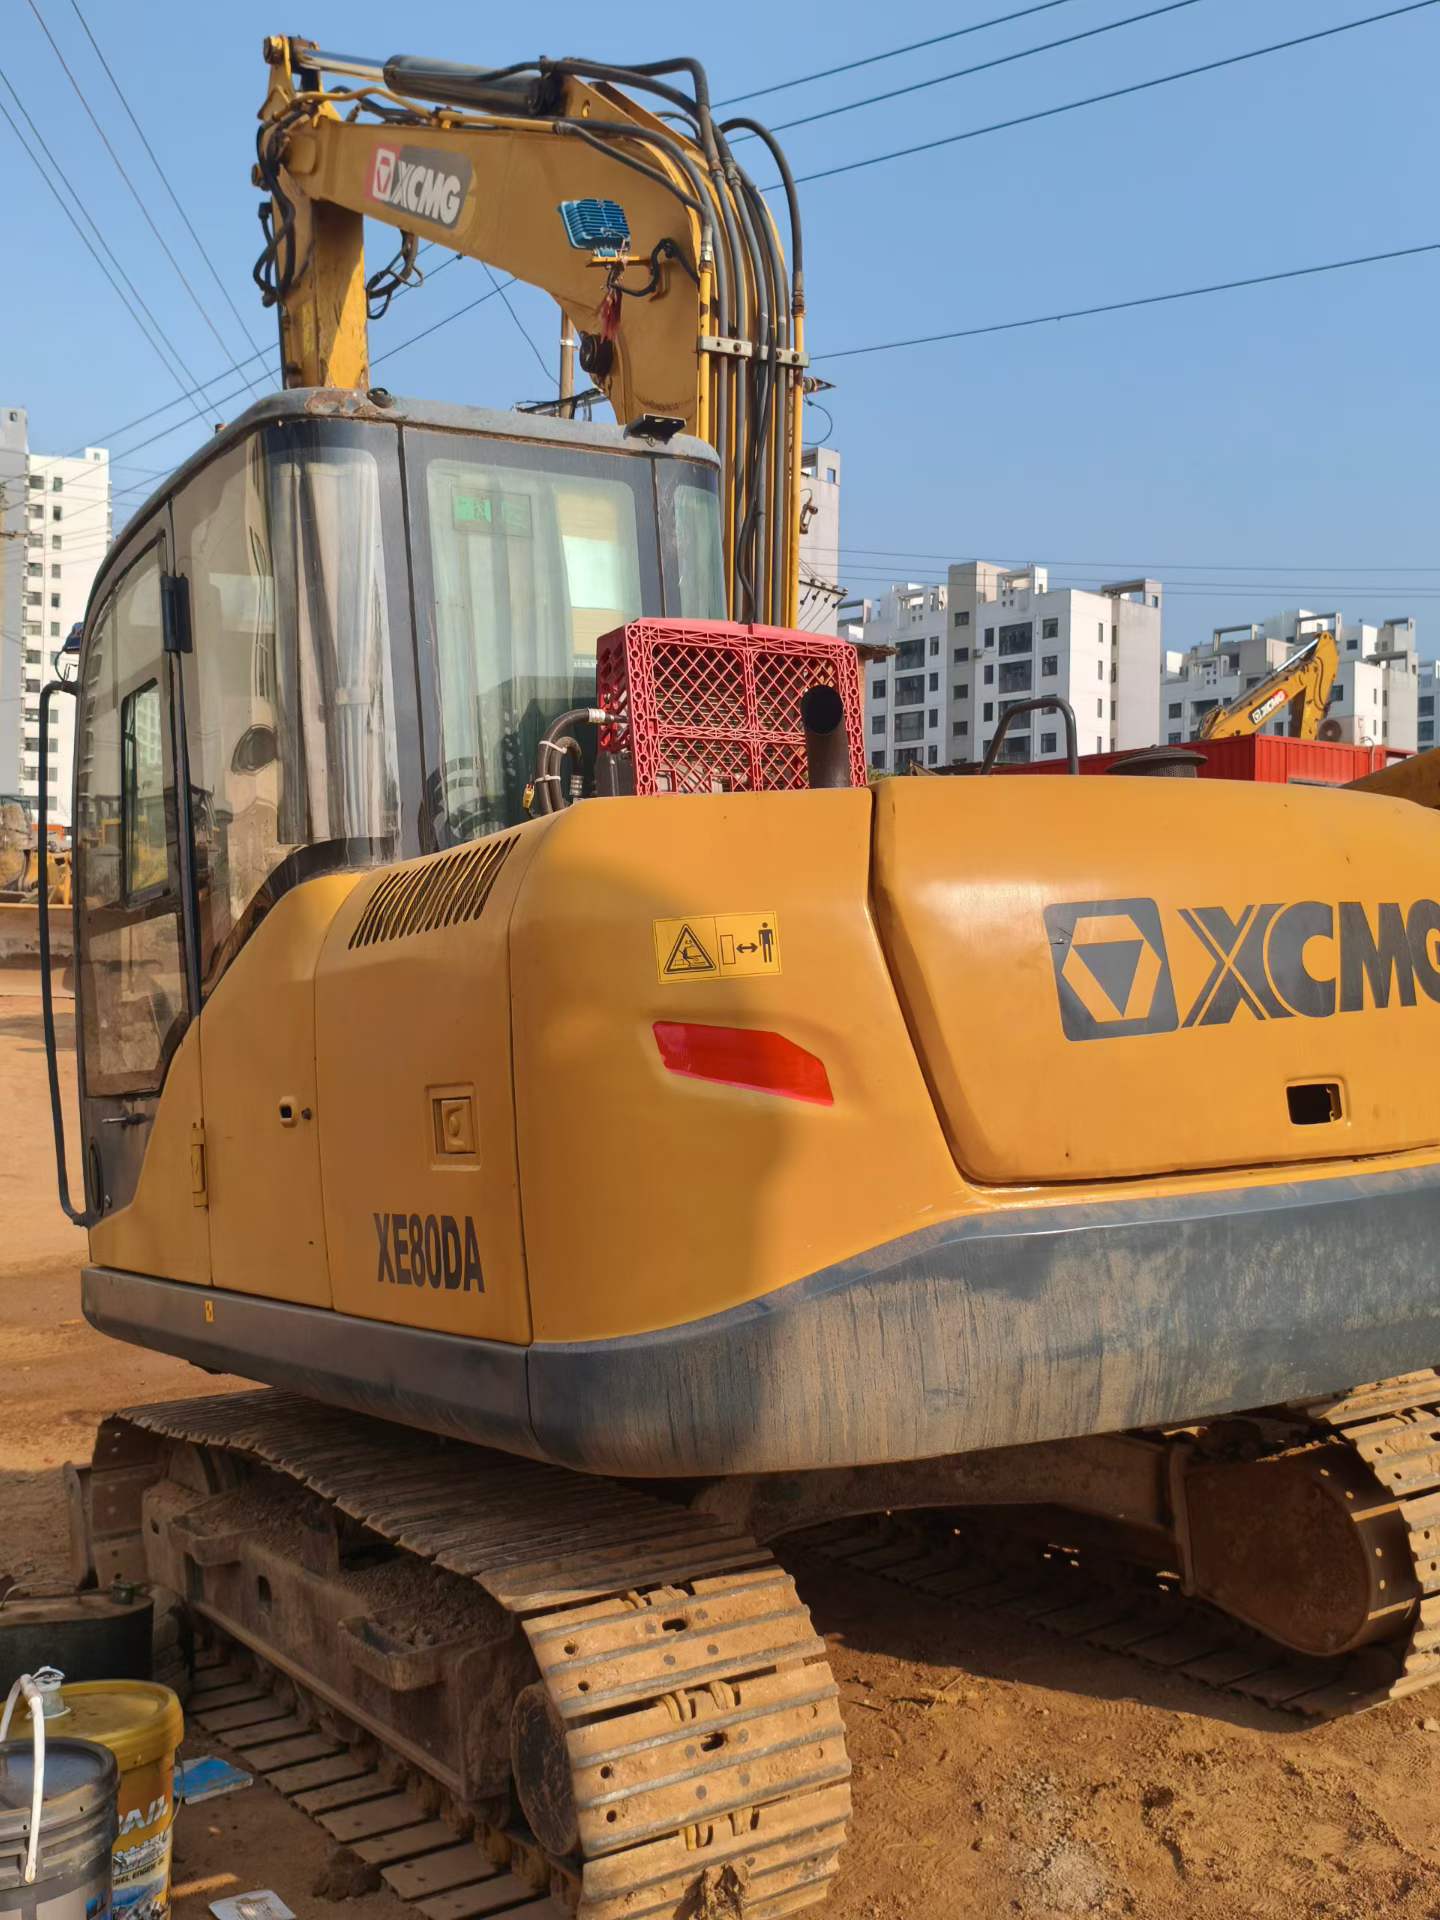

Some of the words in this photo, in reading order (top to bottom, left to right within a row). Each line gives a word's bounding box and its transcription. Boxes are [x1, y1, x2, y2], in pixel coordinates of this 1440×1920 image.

[392, 160, 462, 225] XCMG
[1176, 898, 1440, 1029] XCMG
[372, 1212, 486, 1294] XE80DA
